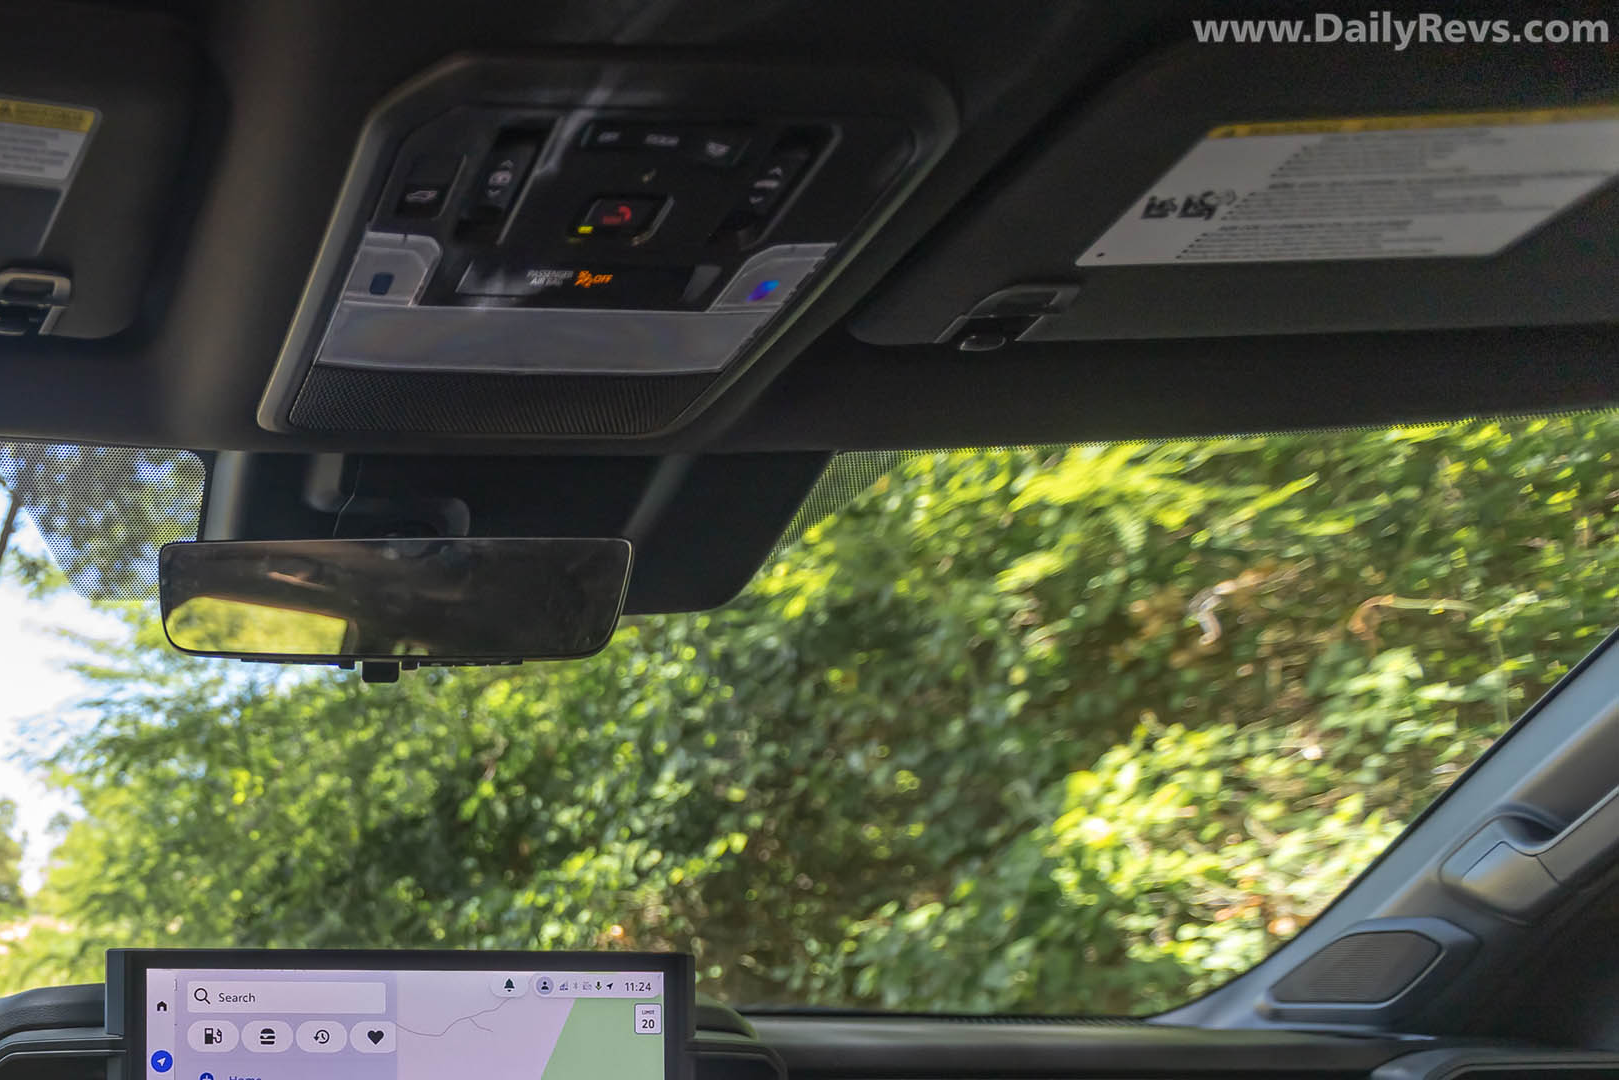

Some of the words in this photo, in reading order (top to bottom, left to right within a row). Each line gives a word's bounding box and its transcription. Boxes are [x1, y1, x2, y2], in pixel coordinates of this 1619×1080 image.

[624, 981, 652, 992] 11:24
[218, 992, 256, 1004] Search
[641, 1019, 655, 1029] 20
